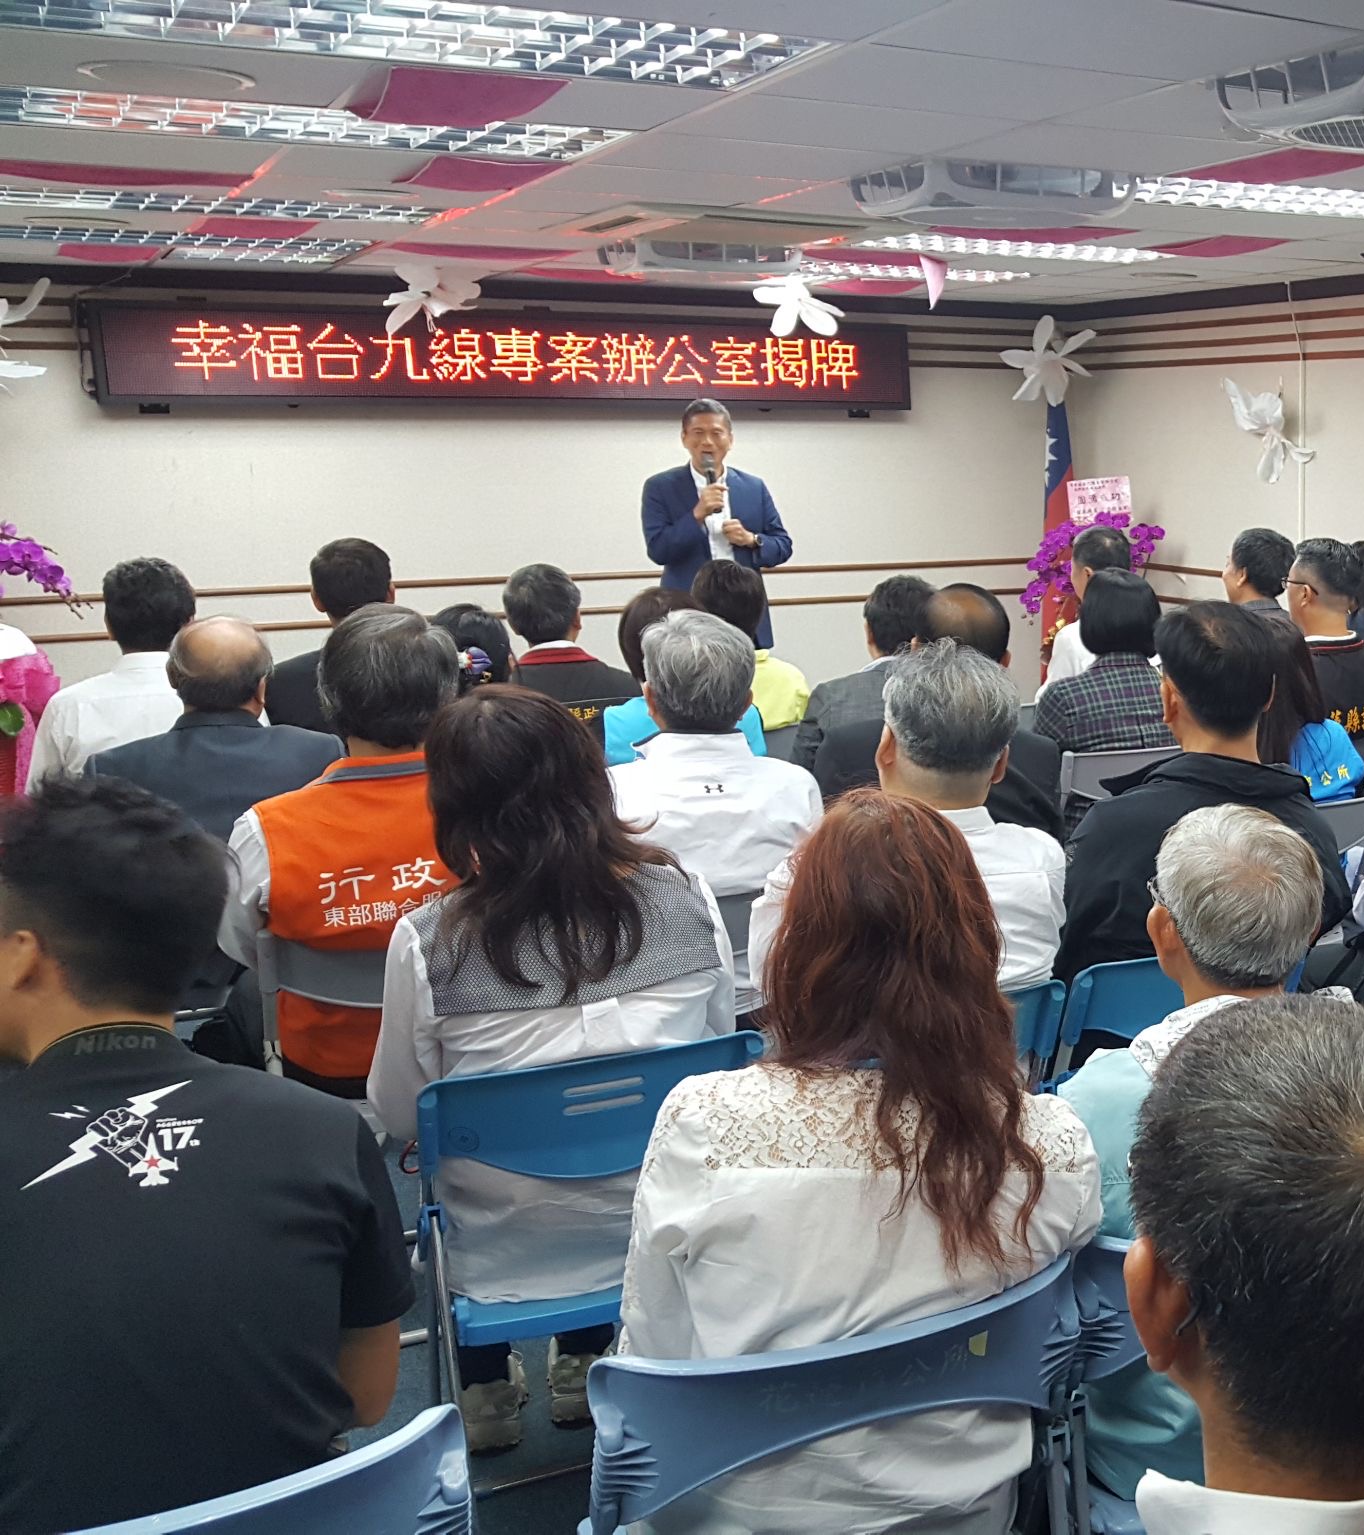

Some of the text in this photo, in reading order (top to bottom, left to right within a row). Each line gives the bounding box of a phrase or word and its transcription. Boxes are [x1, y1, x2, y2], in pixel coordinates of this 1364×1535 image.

[171, 319, 860, 390] 幸福台九線專案辦公室揭牌
[318, 857, 448, 905] 行政
[74, 1032, 157, 1056] Nikon
